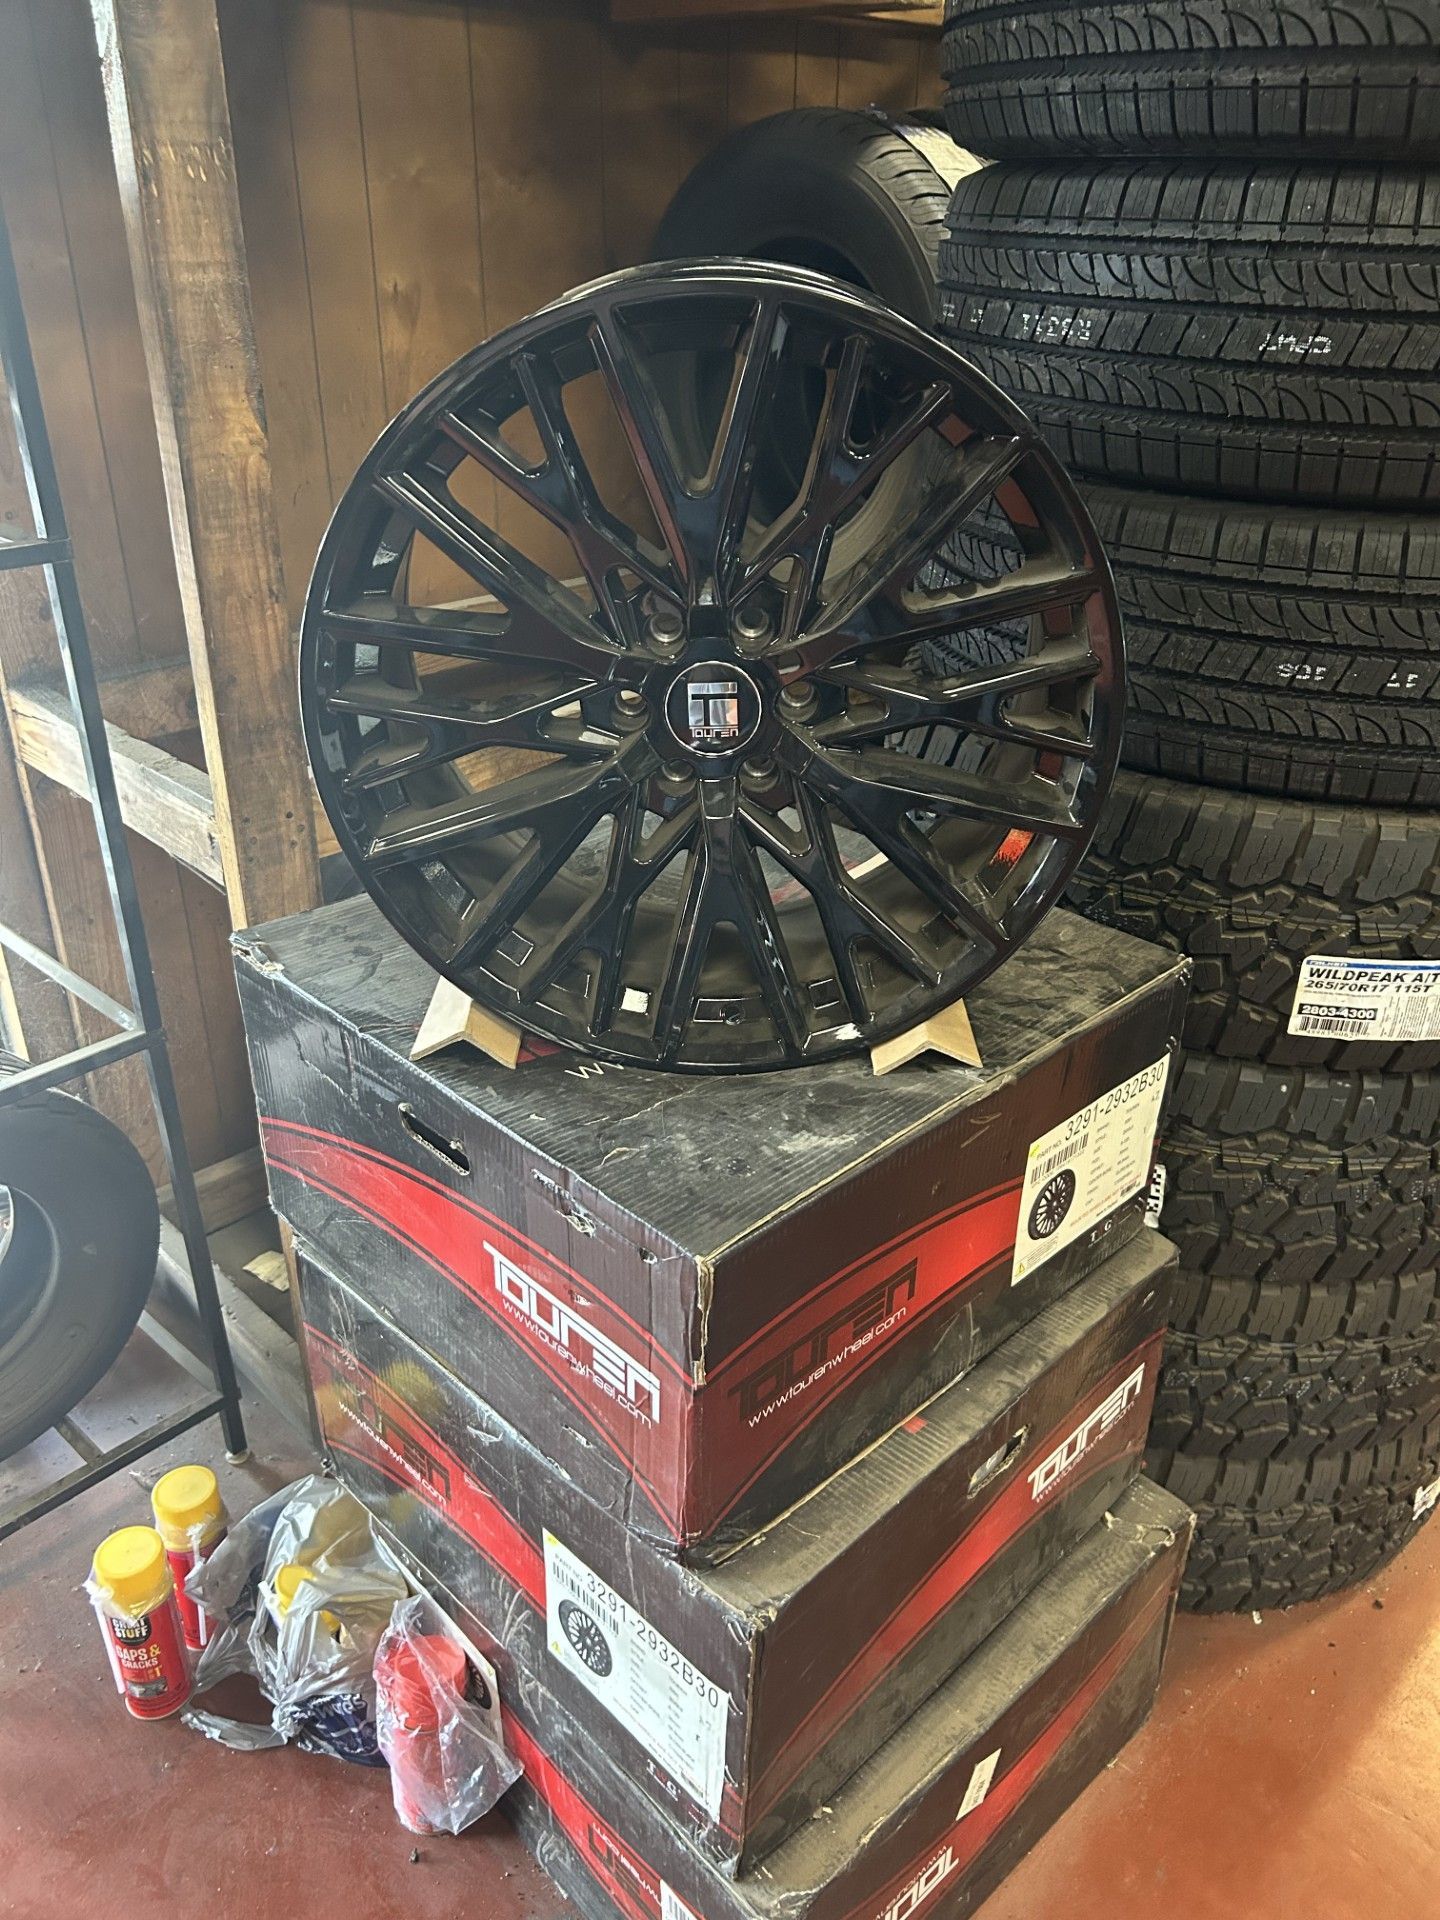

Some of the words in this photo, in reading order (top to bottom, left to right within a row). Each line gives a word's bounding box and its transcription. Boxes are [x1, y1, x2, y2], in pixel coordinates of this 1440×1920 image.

[1308, 967, 1406, 983] WILDPEAK
[1304, 979, 1389, 993] 265/70R17
[1394, 984, 1434, 994] 115T
[1301, 1005, 1375, 1019] 2803-4300
[1065, 1061, 1164, 1141] 3291-2932B30
[748, 1306, 907, 1428] www.tourenwheel.com
[586, 1572, 719, 1709] 3291-2932B30
[115, 1644, 148, 1661] GAPS
[149, 1644, 161, 1658] &
